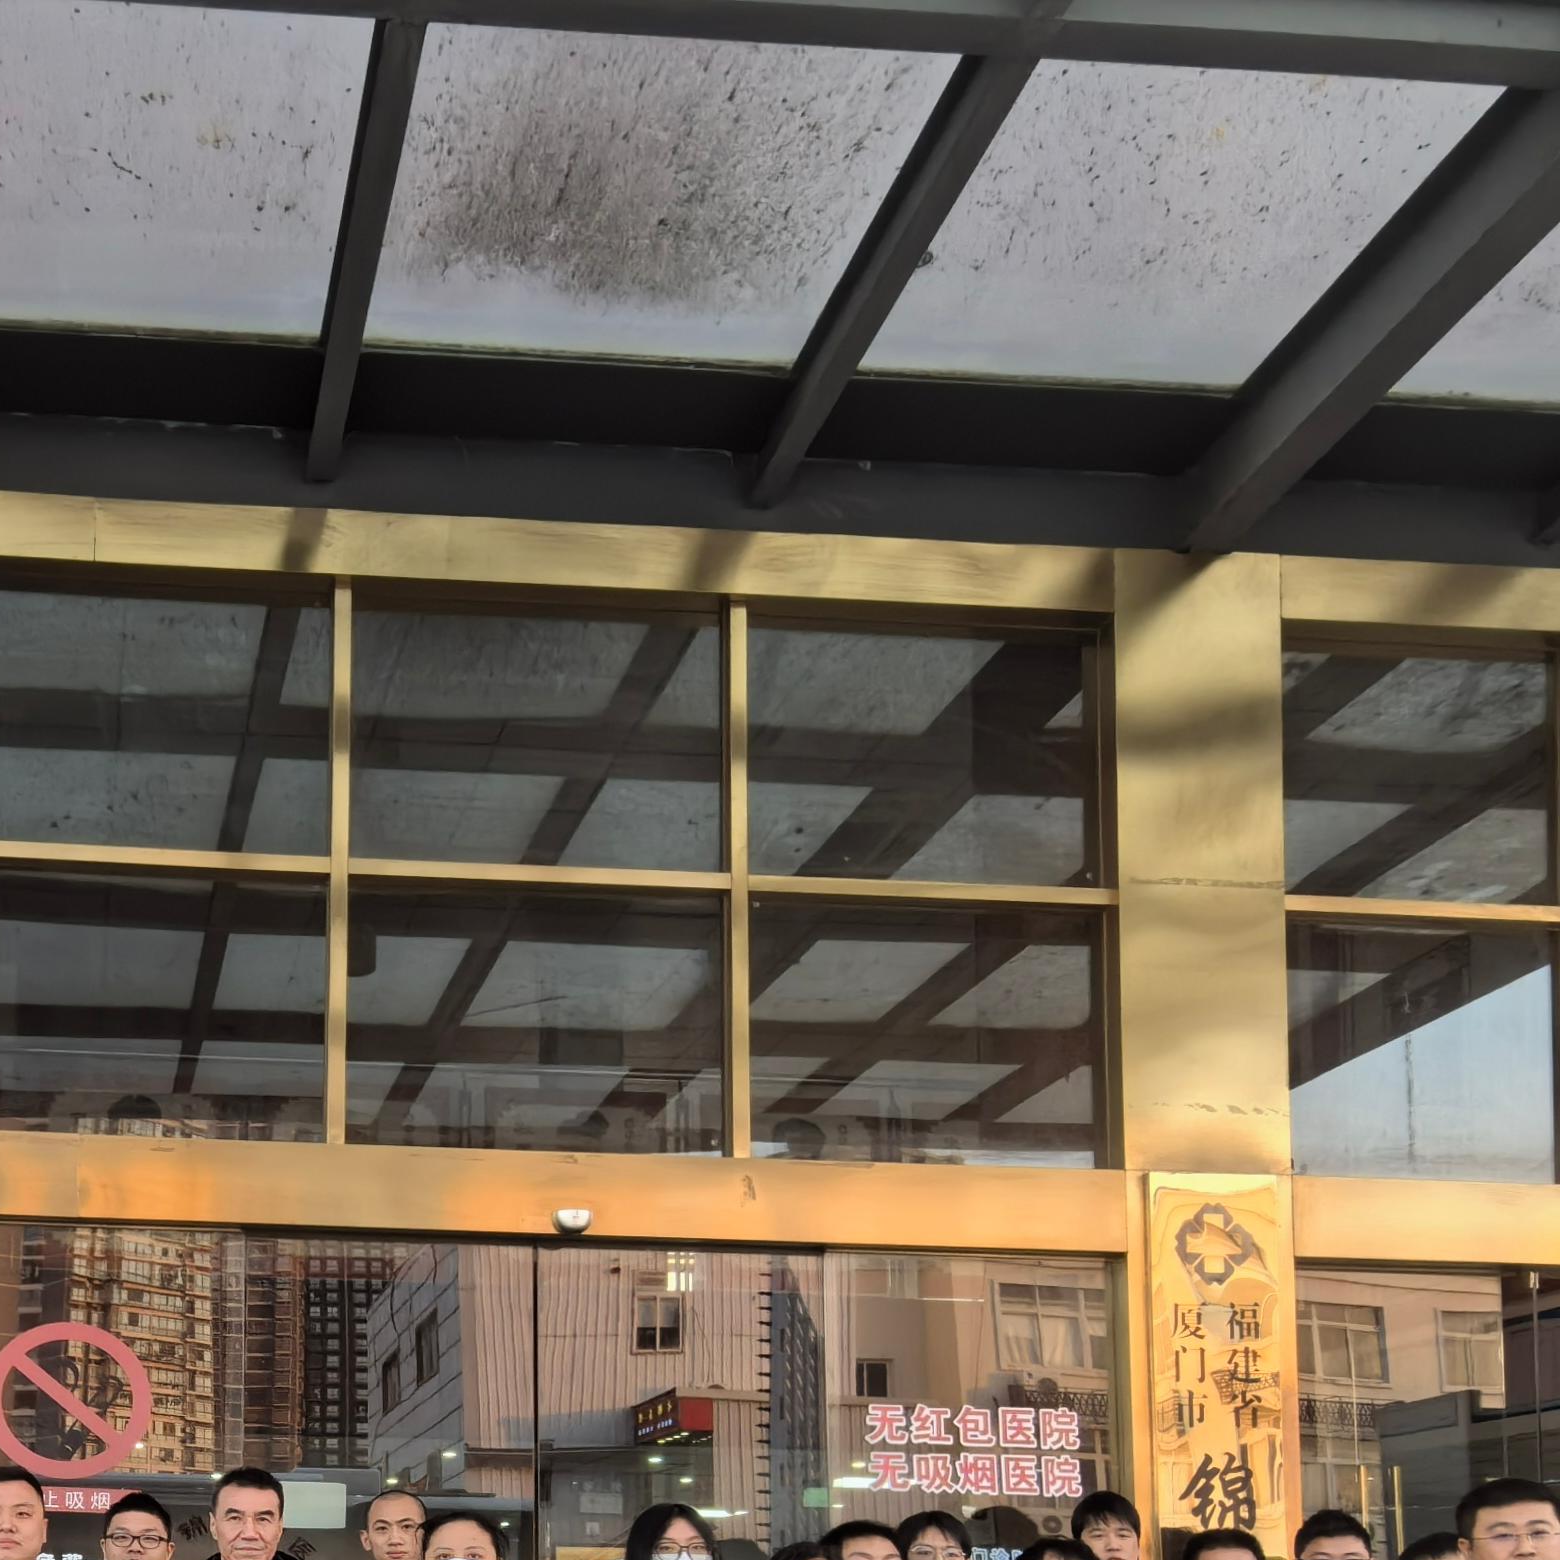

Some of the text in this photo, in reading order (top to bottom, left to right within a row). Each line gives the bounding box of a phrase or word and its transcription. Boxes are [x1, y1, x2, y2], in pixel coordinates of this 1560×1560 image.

[1169, 1301, 1208, 1425] 厦门市
[1226, 1300, 1262, 1429] 福建省
[865, 1403, 1080, 1450] 无红包医院
[869, 1452, 1082, 1497] 无吸烟医院
